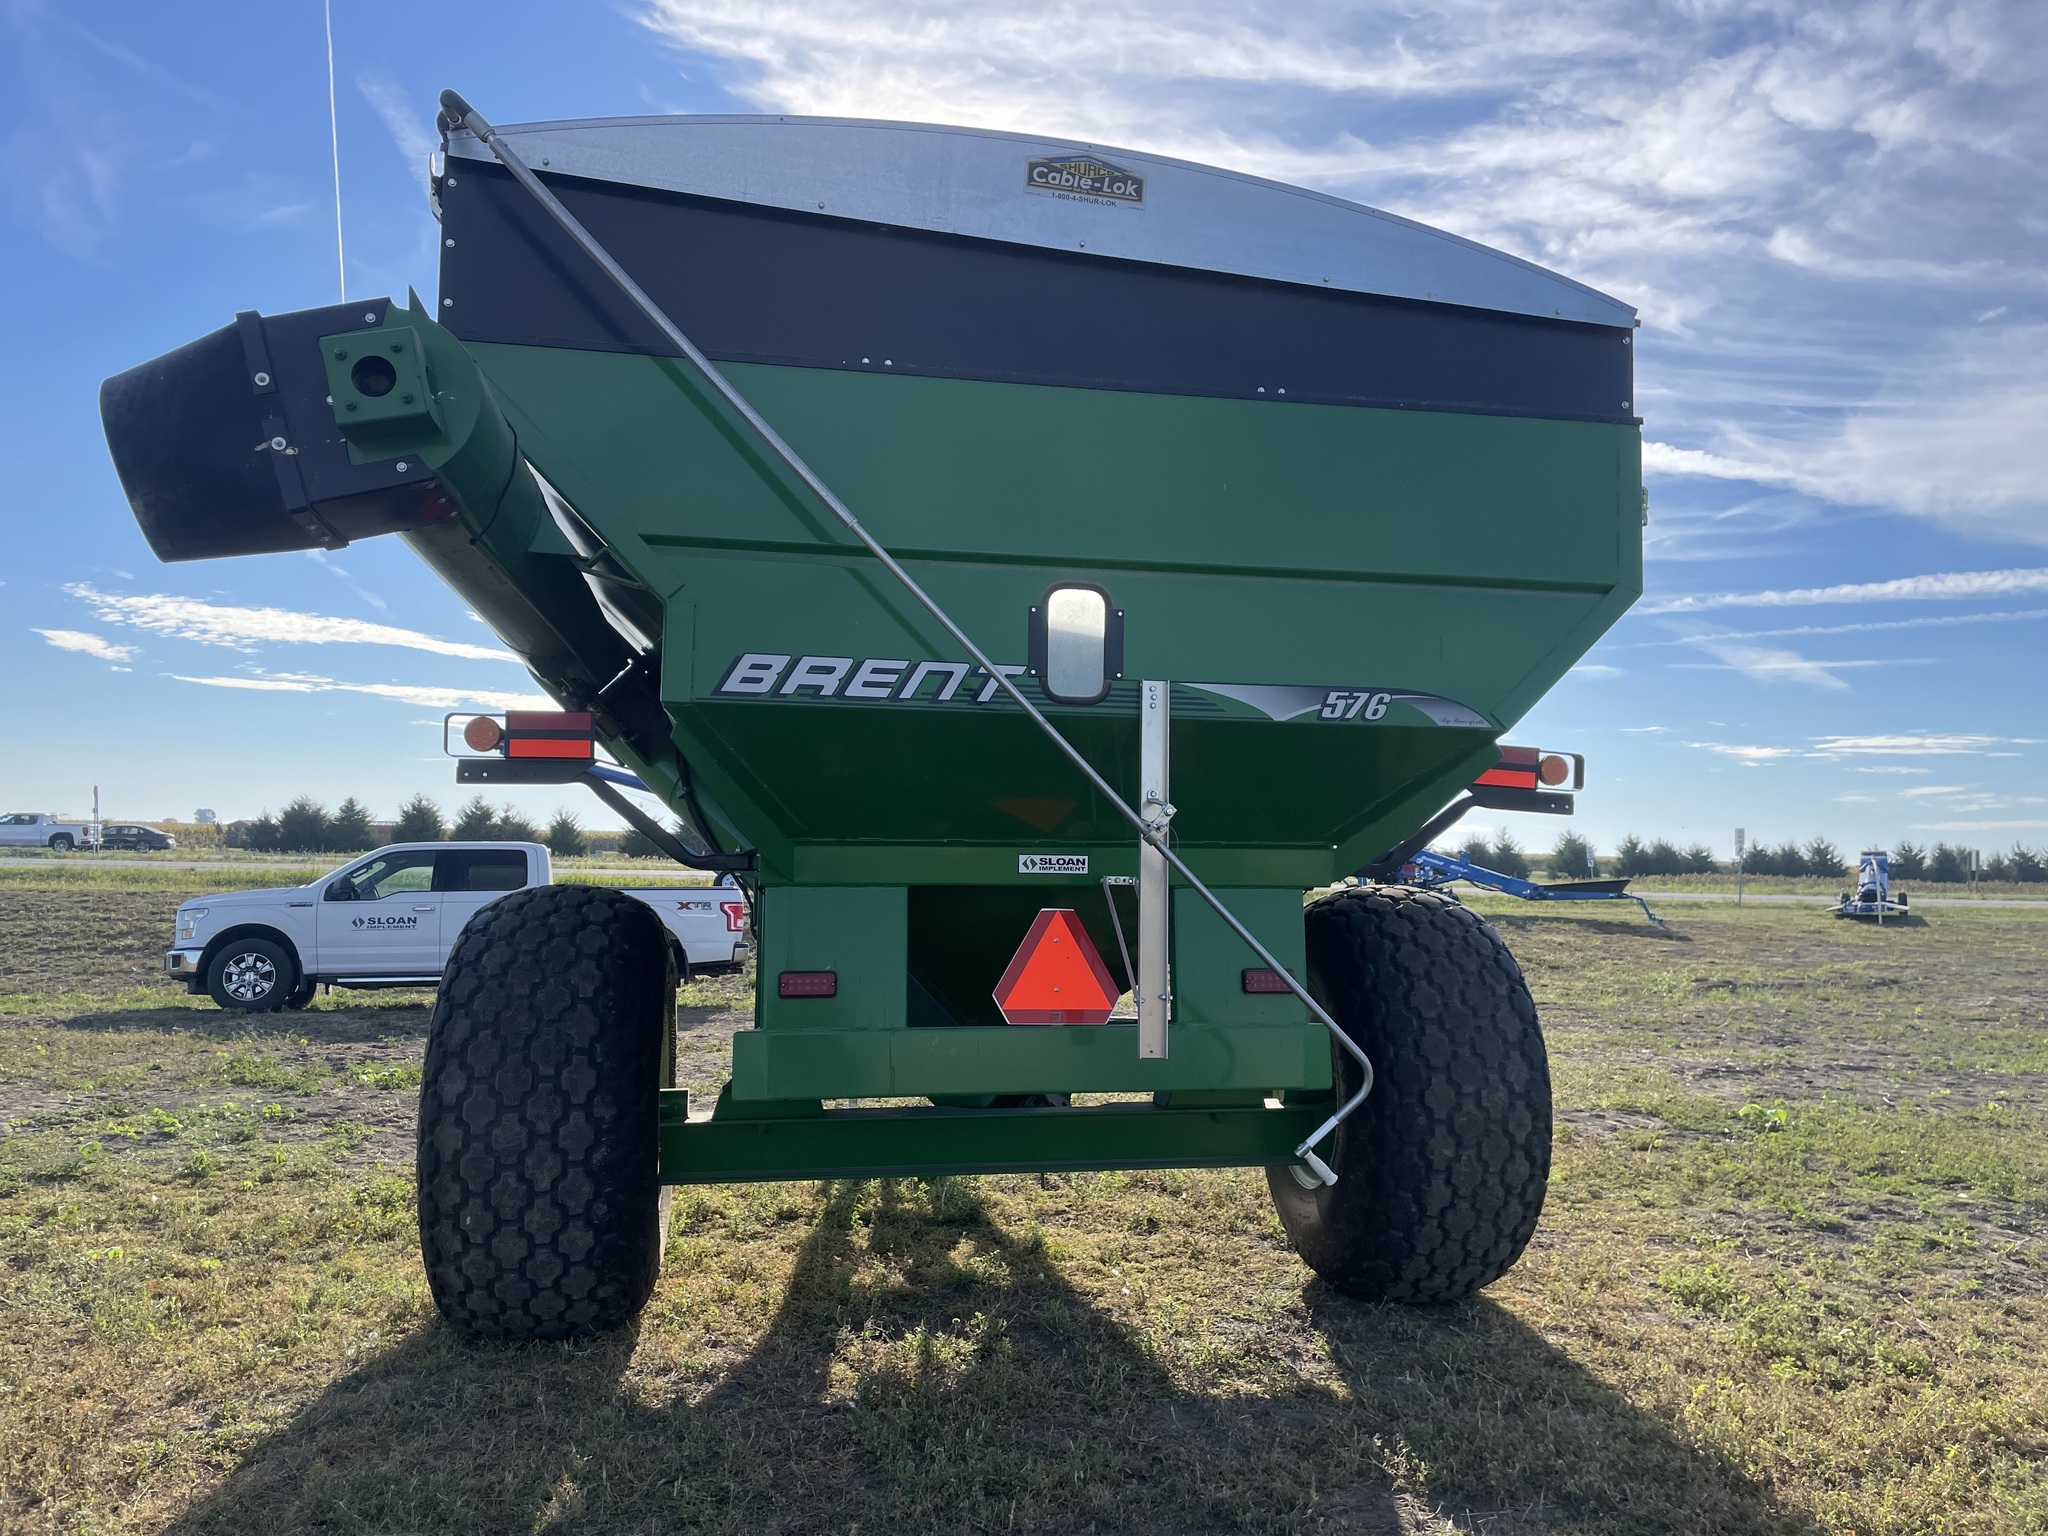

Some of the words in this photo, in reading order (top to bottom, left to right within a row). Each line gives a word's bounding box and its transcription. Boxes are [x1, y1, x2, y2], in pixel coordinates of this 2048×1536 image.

[1032, 166, 1139, 197] Cable-Lok
[1051, 191, 1117, 207] 1-800-4-SHUR-LOK
[715, 652, 1028, 703] BRENT
[1320, 691, 1392, 720] 576
[1039, 857, 1086, 866] SLOAN
[367, 916, 417, 925] SLOAN
